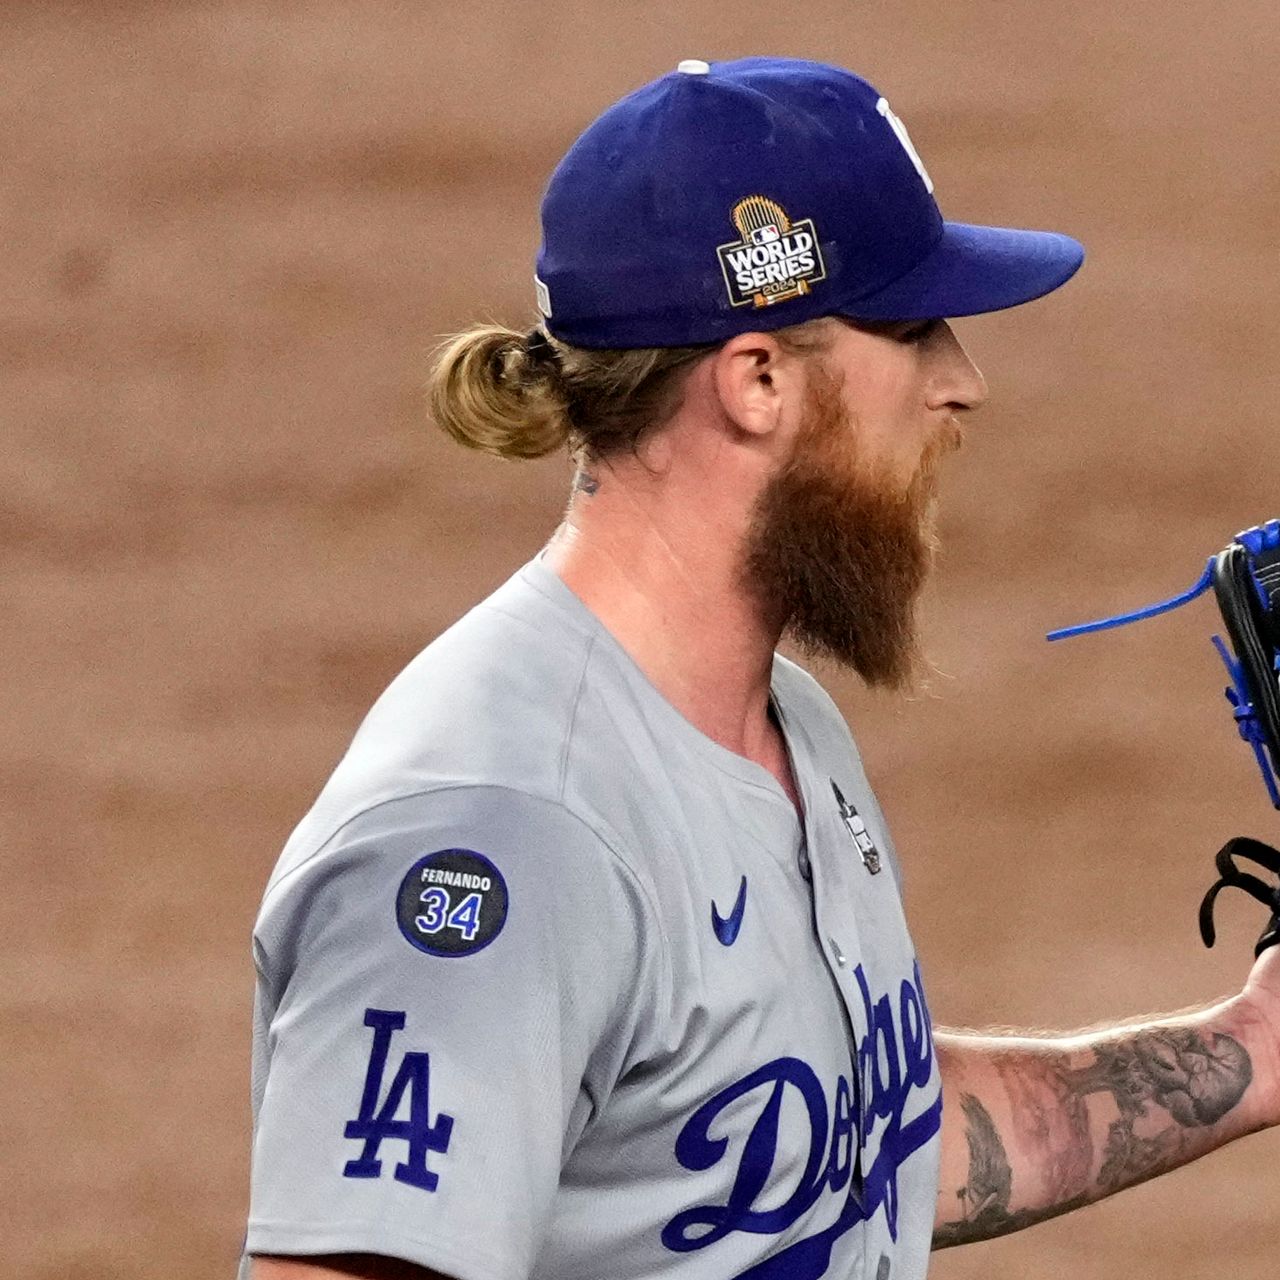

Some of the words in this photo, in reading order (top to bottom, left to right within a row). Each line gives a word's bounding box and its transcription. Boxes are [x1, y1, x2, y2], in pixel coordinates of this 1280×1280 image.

[725, 232, 813, 273] WORLD
[735, 251, 815, 291] SERIES
[762, 278, 797, 296] 2024
[421, 868, 491, 891] FERNANDO
[414, 886, 483, 940] 34
[342, 1006, 455, 1193] LA
[660, 958, 944, 1252] Dodge
